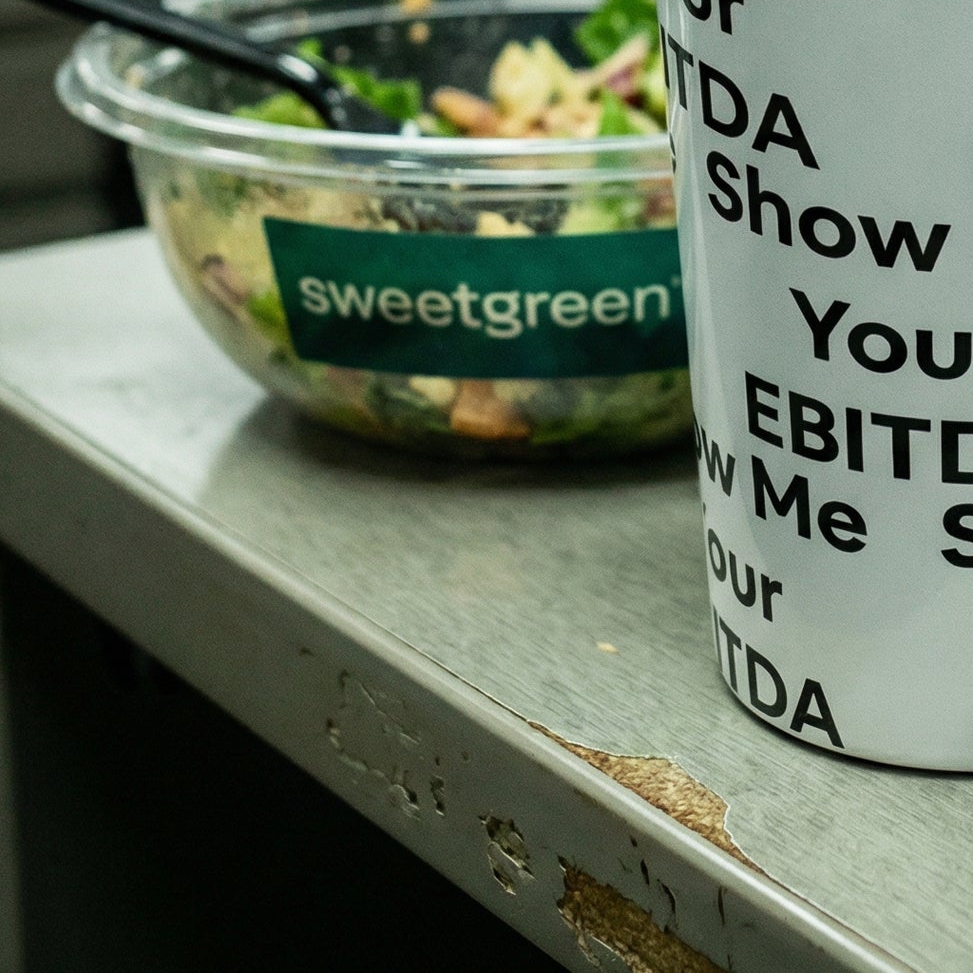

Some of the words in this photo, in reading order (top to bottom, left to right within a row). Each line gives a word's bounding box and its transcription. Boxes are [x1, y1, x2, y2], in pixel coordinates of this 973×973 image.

[706, 150, 952, 274] Show
[299, 276, 670, 340] sweetgreen
[751, 454, 868, 553] Me
[703, 503, 783, 623] our
